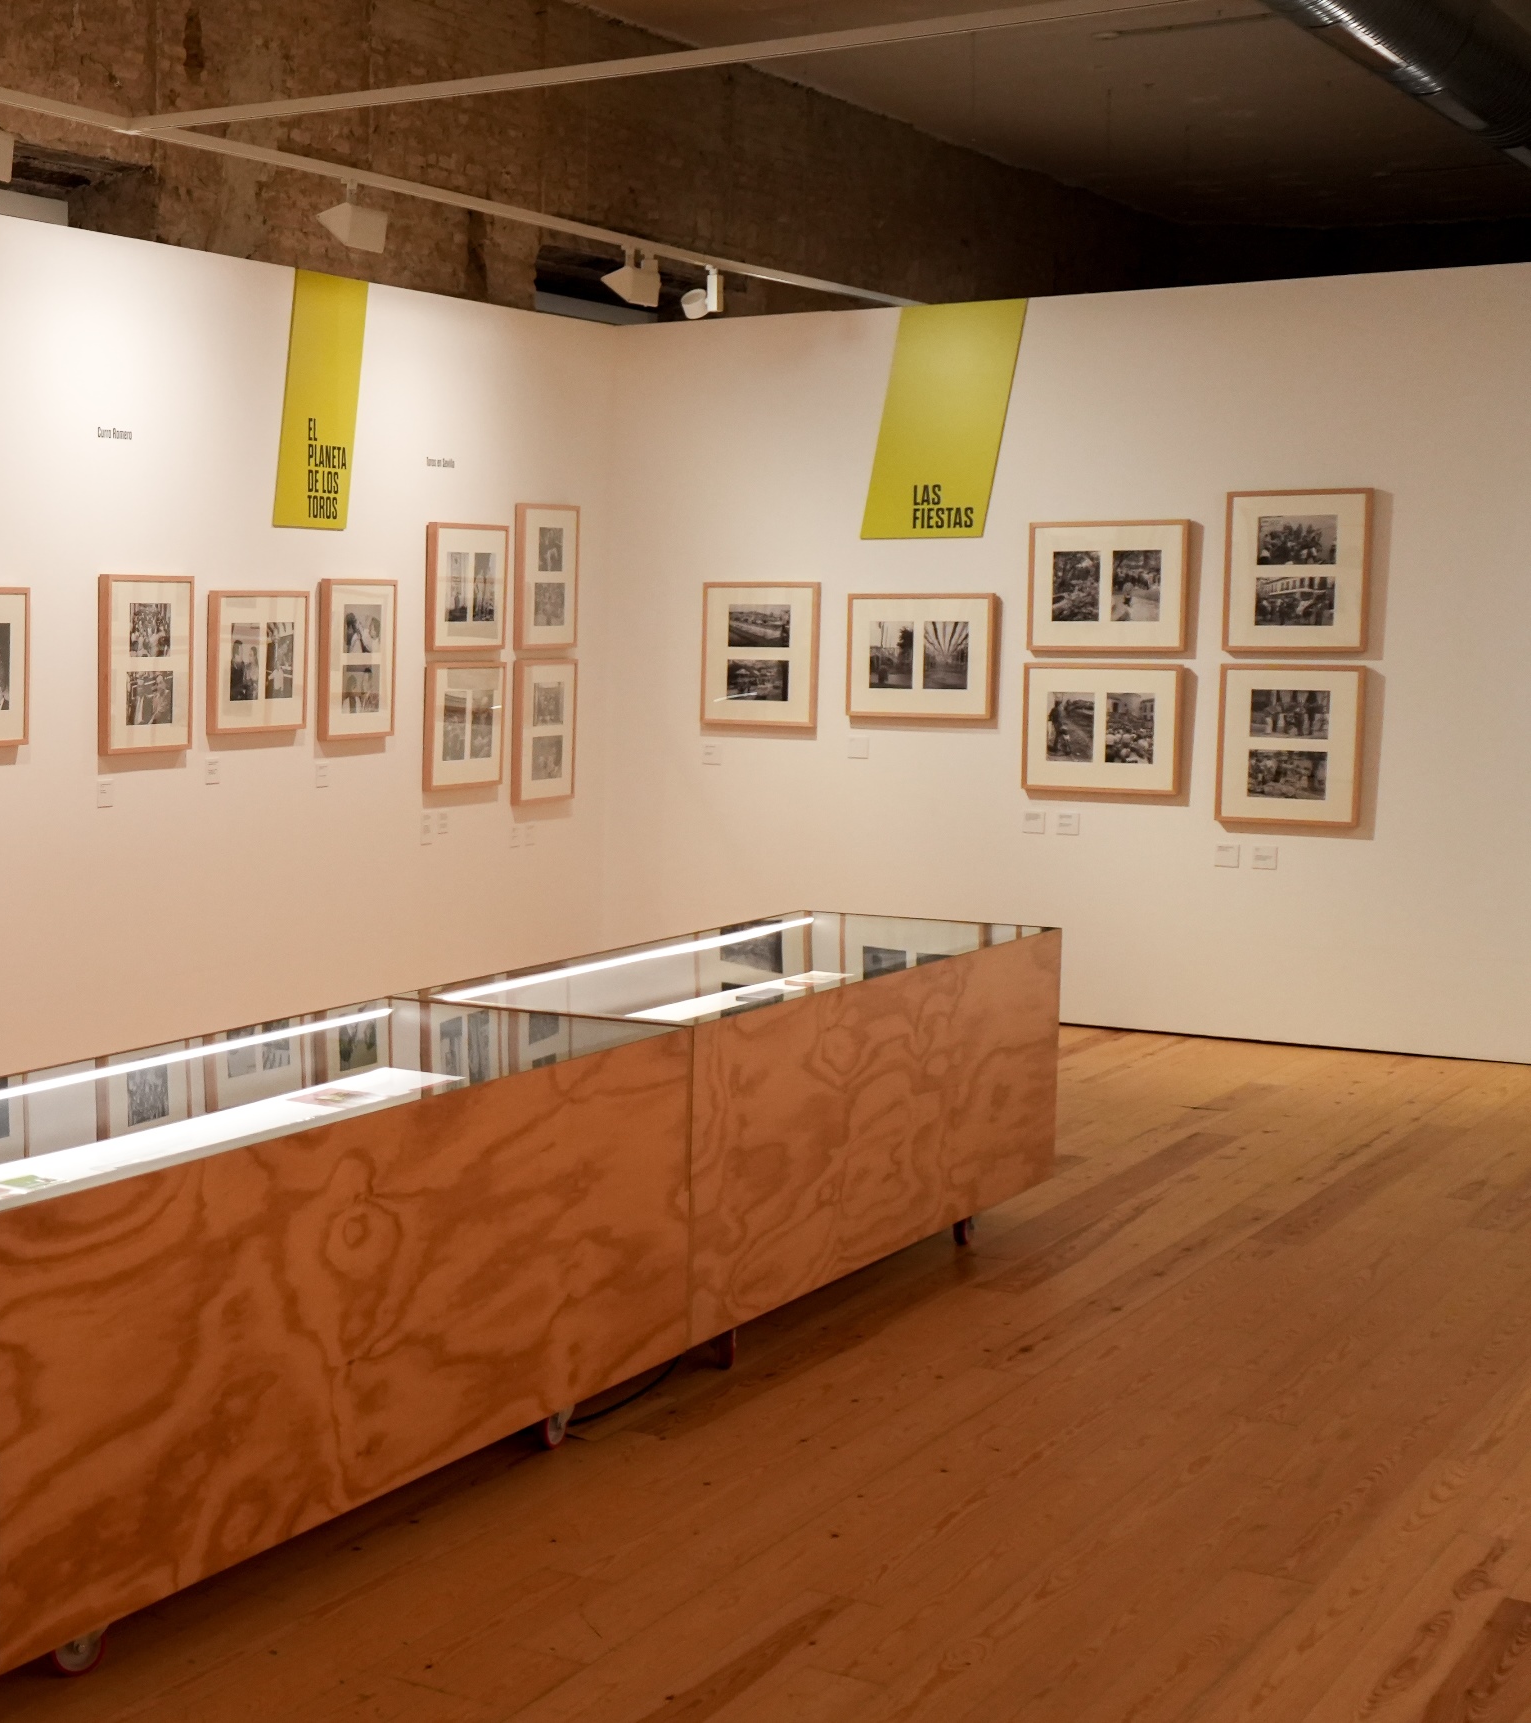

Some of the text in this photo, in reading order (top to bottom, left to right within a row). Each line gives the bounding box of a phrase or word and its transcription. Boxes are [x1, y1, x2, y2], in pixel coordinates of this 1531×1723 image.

[112, 428, 132, 440] Romero
[308, 418, 318, 441] EL
[307, 444, 347, 470] PLANETA
[307, 469, 339, 494] DE LOS
[913, 484, 942, 506] LAS
[307, 494, 338, 520] TOROS
[912, 506, 974, 529] FIESTAS
